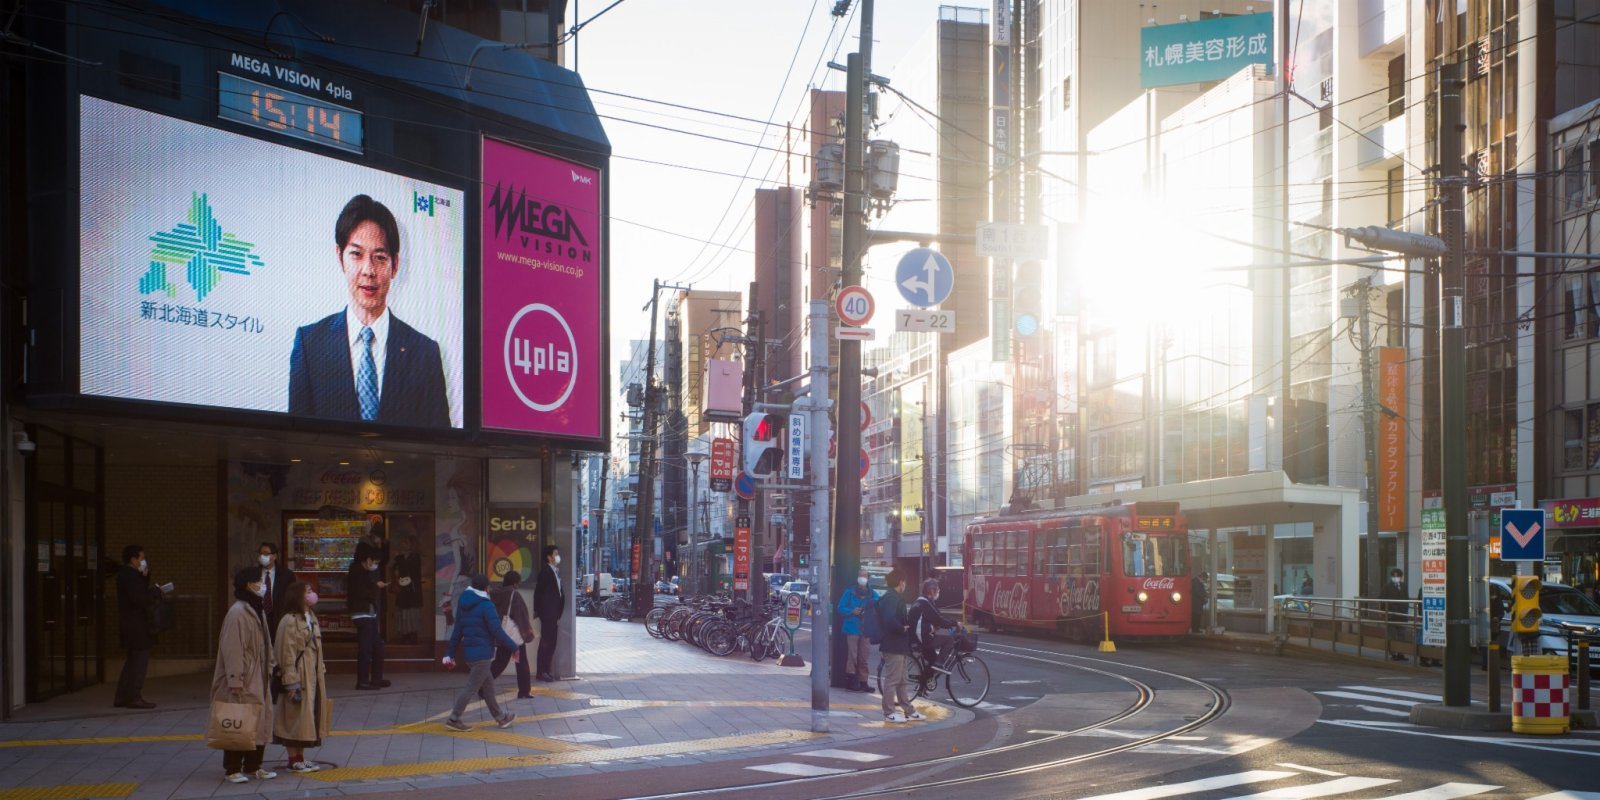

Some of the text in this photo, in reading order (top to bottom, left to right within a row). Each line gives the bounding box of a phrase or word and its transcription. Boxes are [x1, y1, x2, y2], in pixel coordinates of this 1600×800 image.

[1145, 33, 1267, 68] 札幌美容形成
[231, 53, 353, 101] MEGA VISION 4pla
[251, 88, 340, 144] 15:14
[488, 179, 588, 246] MEGA
[497, 251, 584, 279] www.mega-vision.co.jp
[521, 236, 591, 263] VISION
[140, 300, 264, 333] 新北海道スタイル
[845, 297, 867, 315] 40
[514, 337, 569, 376] 4pla
[713, 441, 725, 476] LIPS
[1386, 421, 1398, 527] カラダファクトリー
[490, 516, 537, 531] Seria
[738, 530, 747, 562] LIPS
[1143, 577, 1175, 590] Coca-Cola
[221, 718, 242, 730] GU
